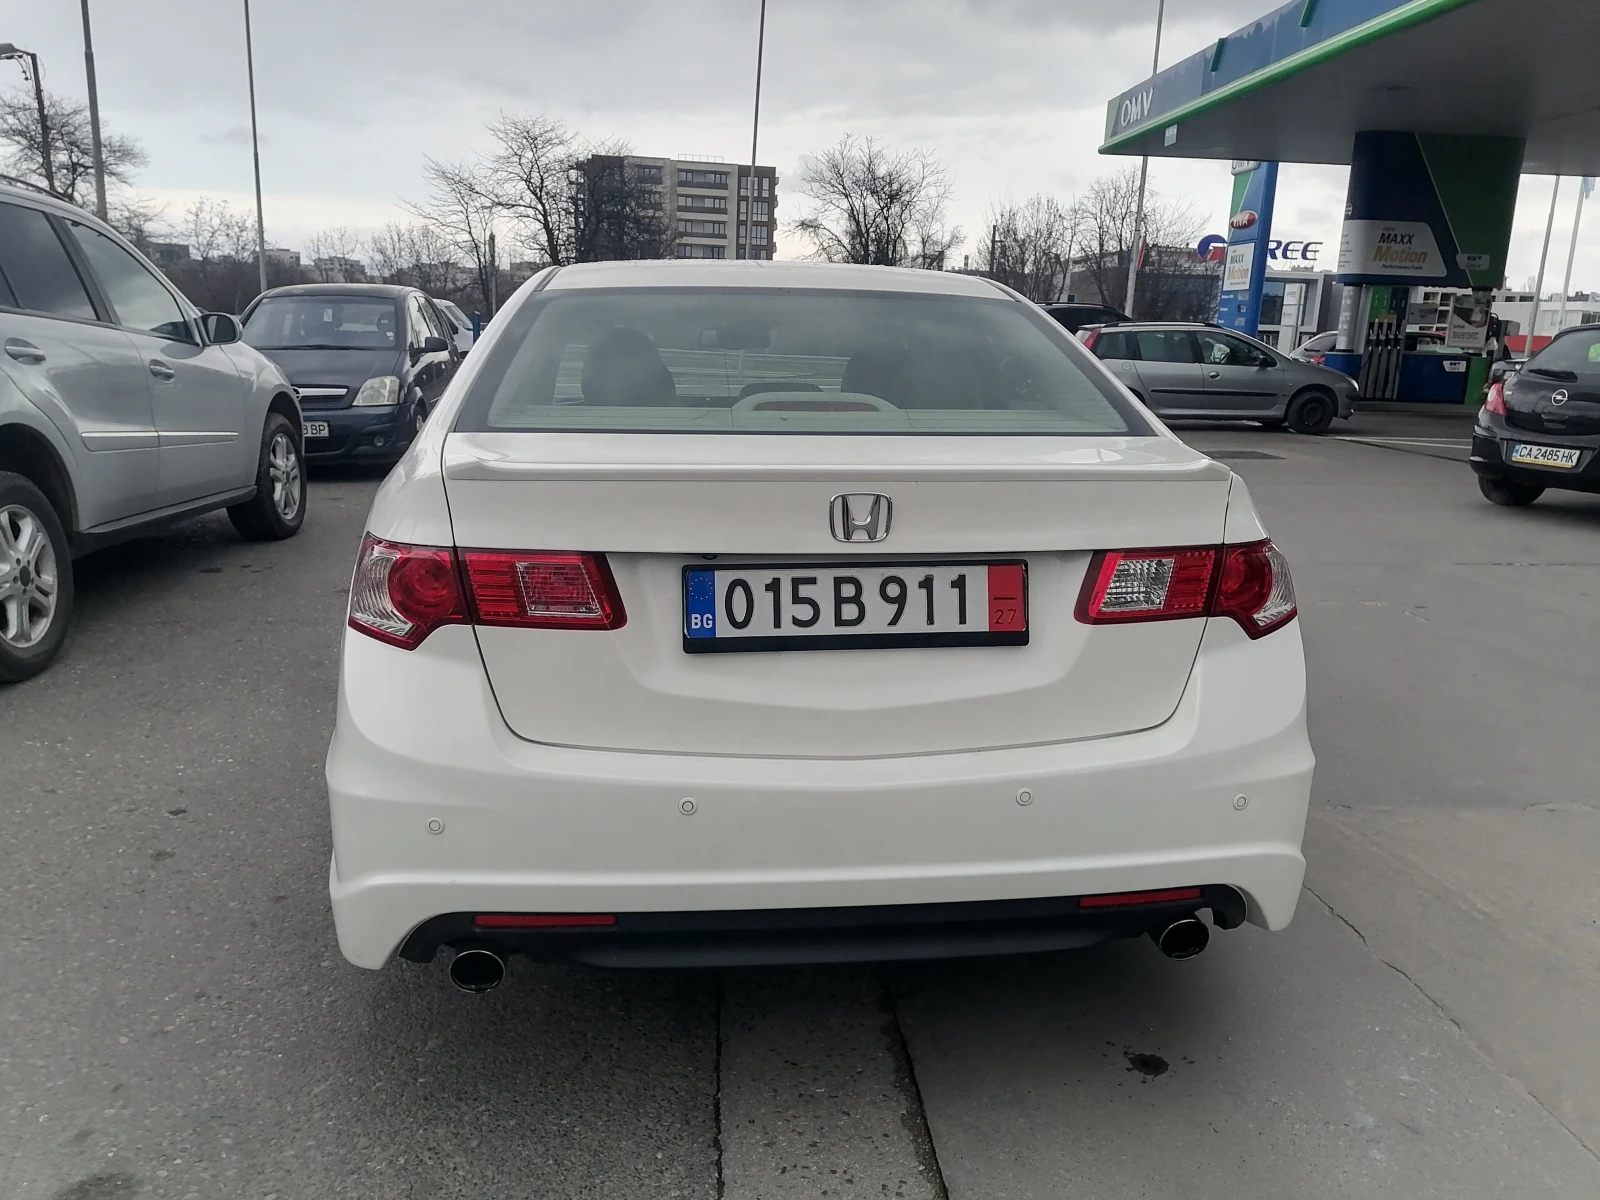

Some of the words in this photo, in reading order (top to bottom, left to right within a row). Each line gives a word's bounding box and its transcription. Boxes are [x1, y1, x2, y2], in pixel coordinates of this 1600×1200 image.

[1121, 87, 1154, 127] OMV
[1378, 232, 1415, 245] MAXX
[1373, 246, 1428, 263] Motion
[311, 424, 326, 435] BP
[1519, 446, 1532, 458] CA
[1534, 447, 1560, 461] 2485
[1560, 451, 1577, 464] HK
[691, 613, 713, 629] BG
[994, 608, 1017, 625] 27
